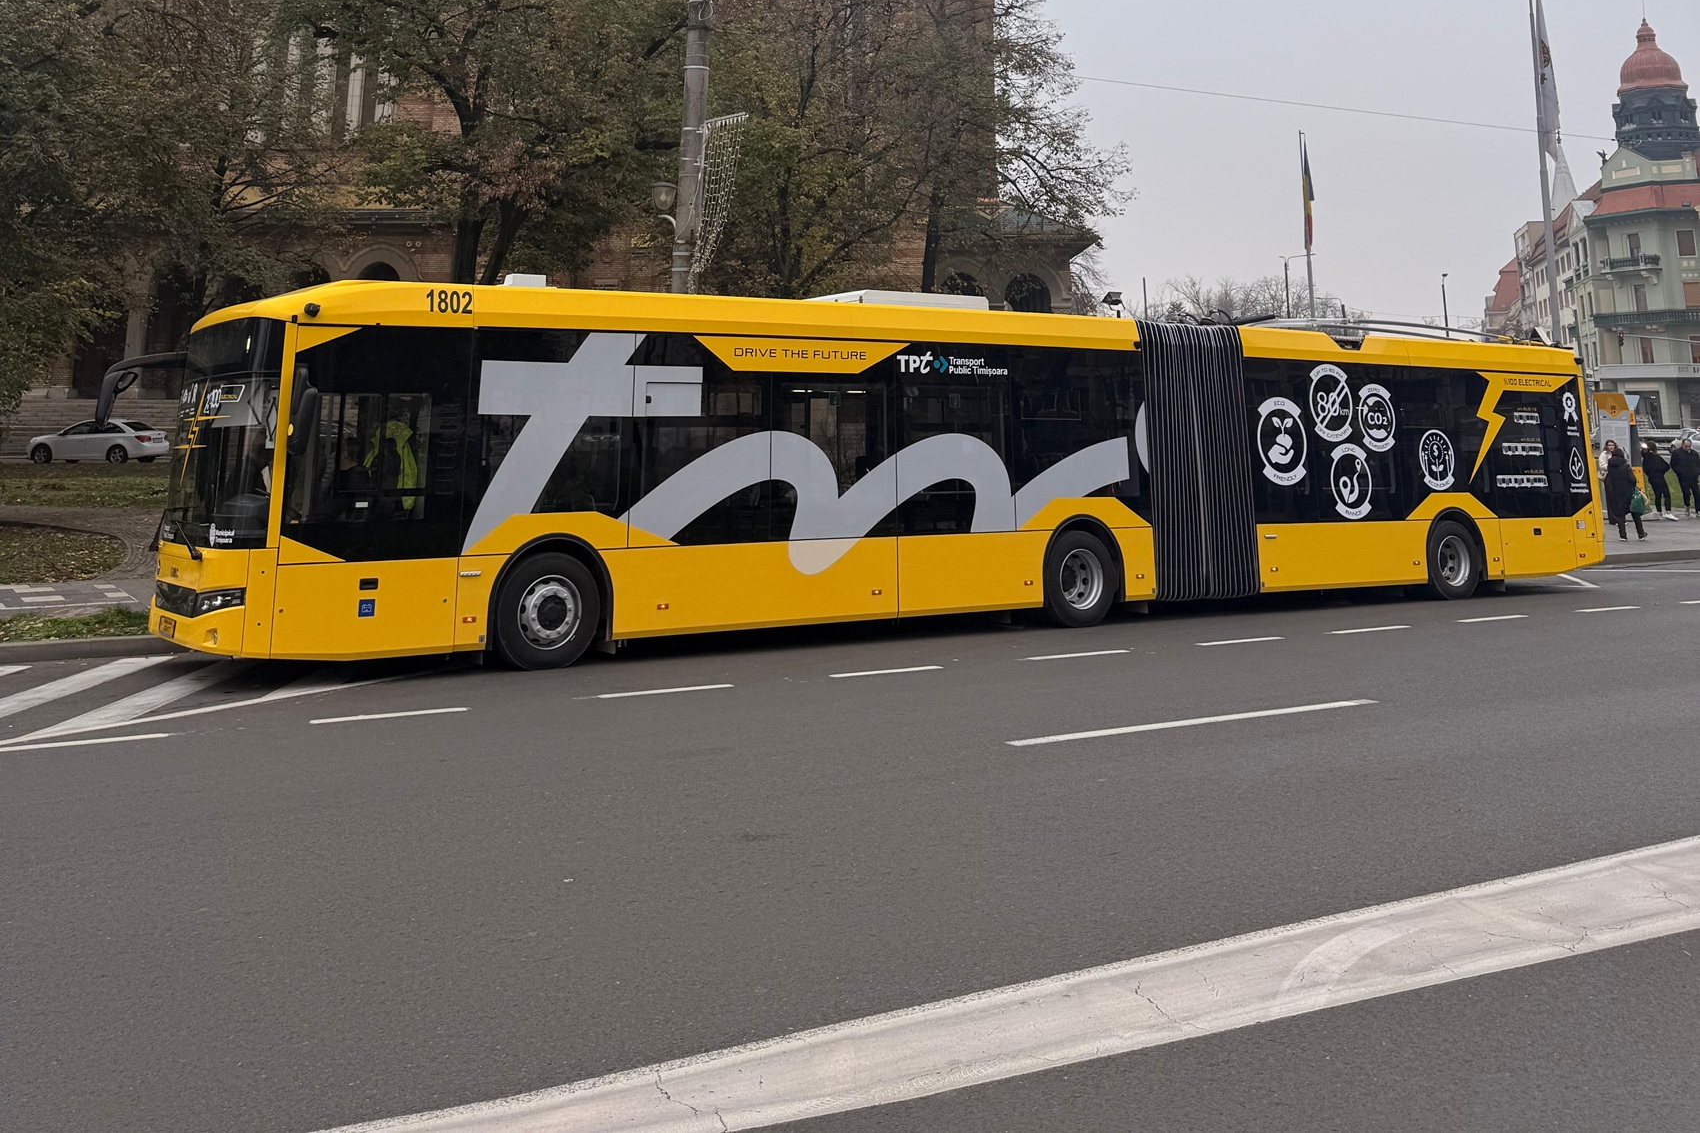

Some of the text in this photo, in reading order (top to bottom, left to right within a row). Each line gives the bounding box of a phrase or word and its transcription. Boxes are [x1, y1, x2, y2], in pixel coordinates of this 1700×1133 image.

[426, 288, 473, 315] 1802
[733, 347, 867, 360] DRIVE THE FUTURE
[948, 356, 985, 367] Transport
[948, 365, 1008, 378] Public Timișoara
[1518, 378, 1552, 387] ELECTRICAL
[1316, 391, 1350, 417] 80 km
[1368, 440, 1390, 450] EMISSION
[1273, 473, 1297, 482] FRIENDLY
[1345, 509, 1362, 517] RANGE
